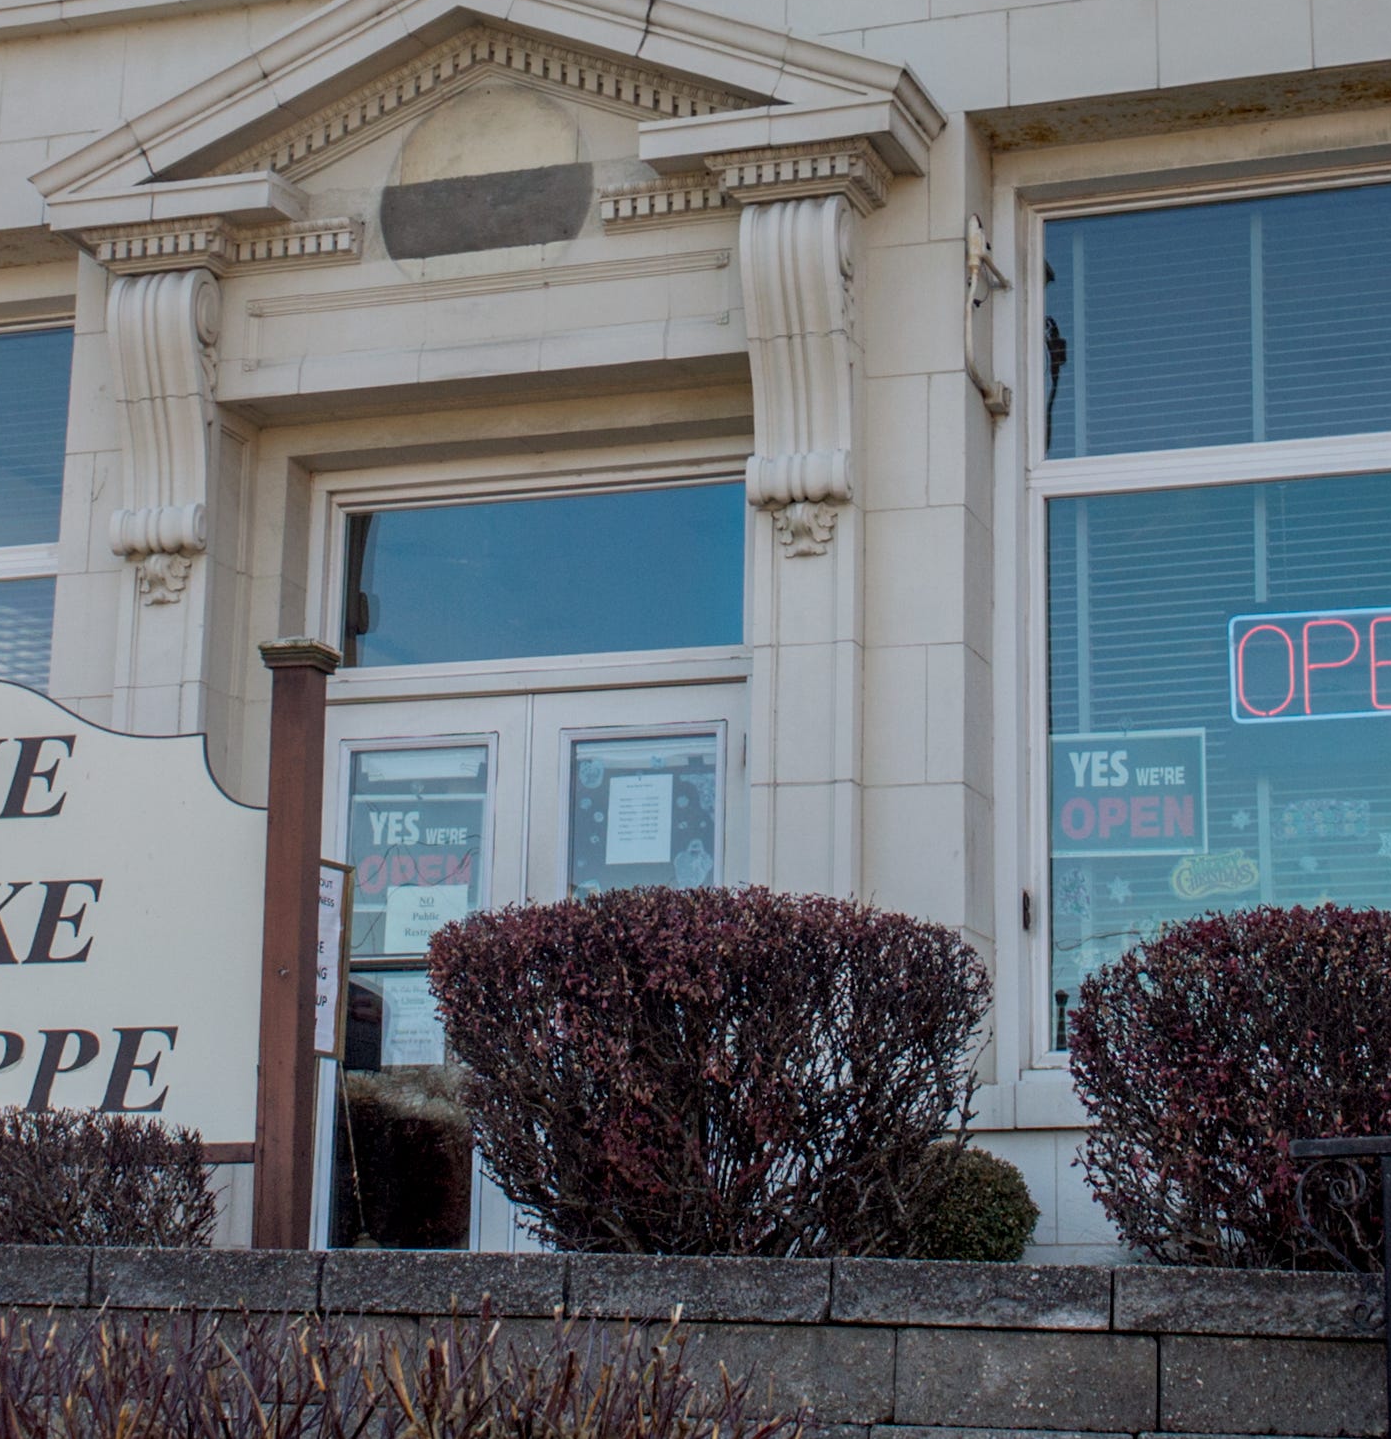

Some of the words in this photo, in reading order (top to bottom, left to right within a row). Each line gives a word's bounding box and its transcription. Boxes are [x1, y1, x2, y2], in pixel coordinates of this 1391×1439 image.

[1069, 750, 1129, 788] YES
[1135, 766, 1185, 786] WE'RE
[369, 811, 421, 845] YES
[425, 827, 468, 845] WE'RE
[1061, 794, 1195, 841] OPEN
[358, 854, 472, 894] OPEN
[412, 912, 440, 922] Public
[419, 896, 434, 907] NO
